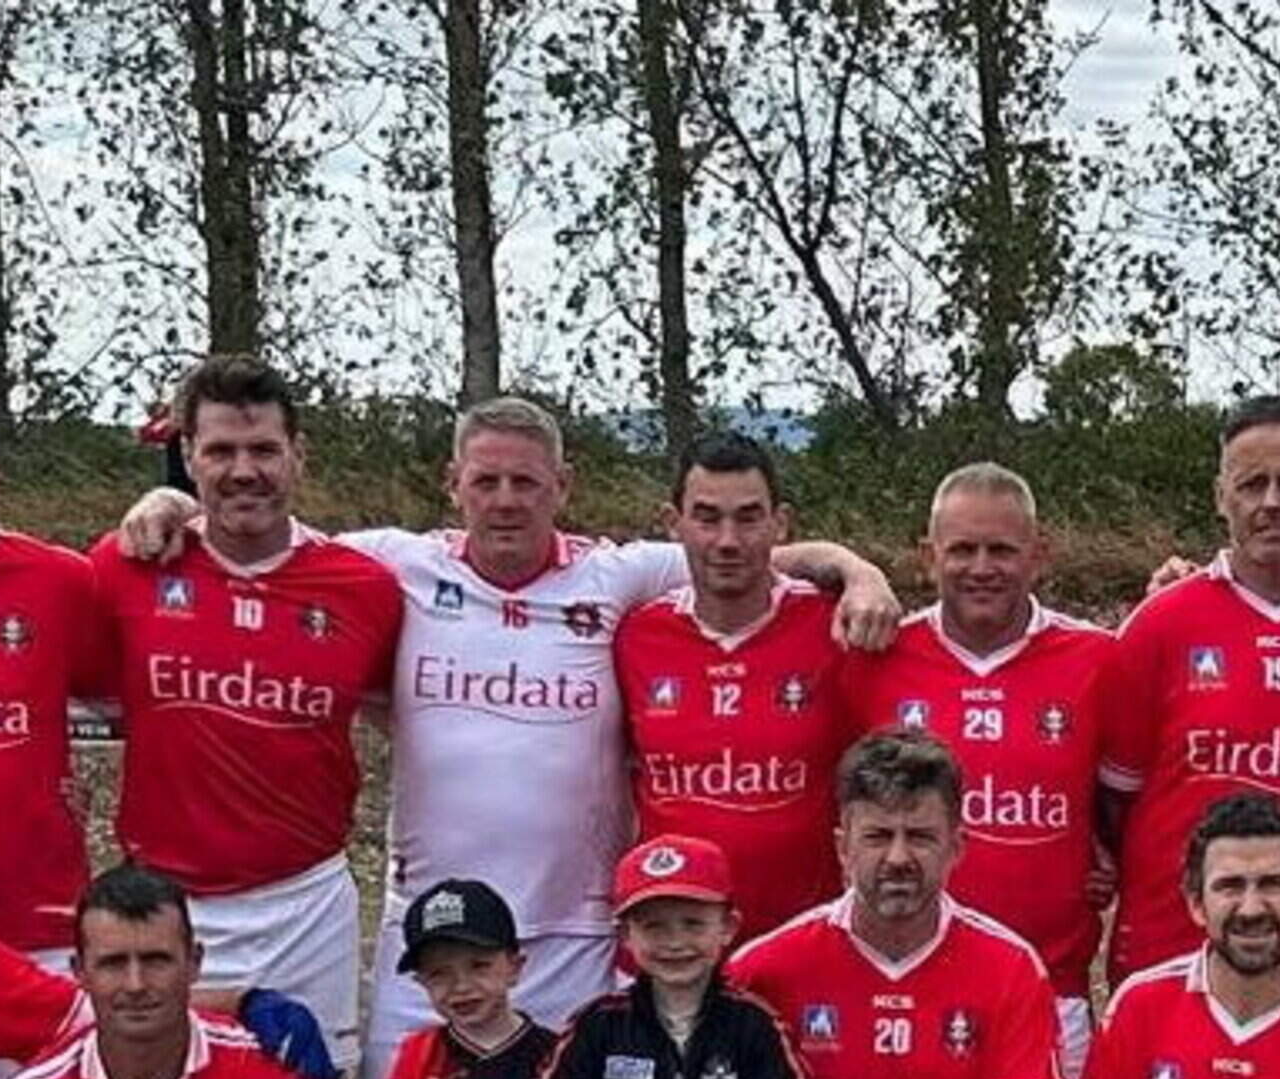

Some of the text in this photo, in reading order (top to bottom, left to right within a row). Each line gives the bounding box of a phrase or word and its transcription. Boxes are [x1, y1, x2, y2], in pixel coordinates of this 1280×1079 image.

[232, 596, 264, 630] 10
[500, 600, 531, 630] 16
[148, 654, 334, 718] Eirdata
[414, 655, 599, 710] Eirdata
[711, 683, 742, 716] 12
[963, 707, 1003, 741] 29
[646, 748, 807, 796] Eirdata
[962, 775, 1069, 828] data
[874, 1017, 912, 1055] 20
